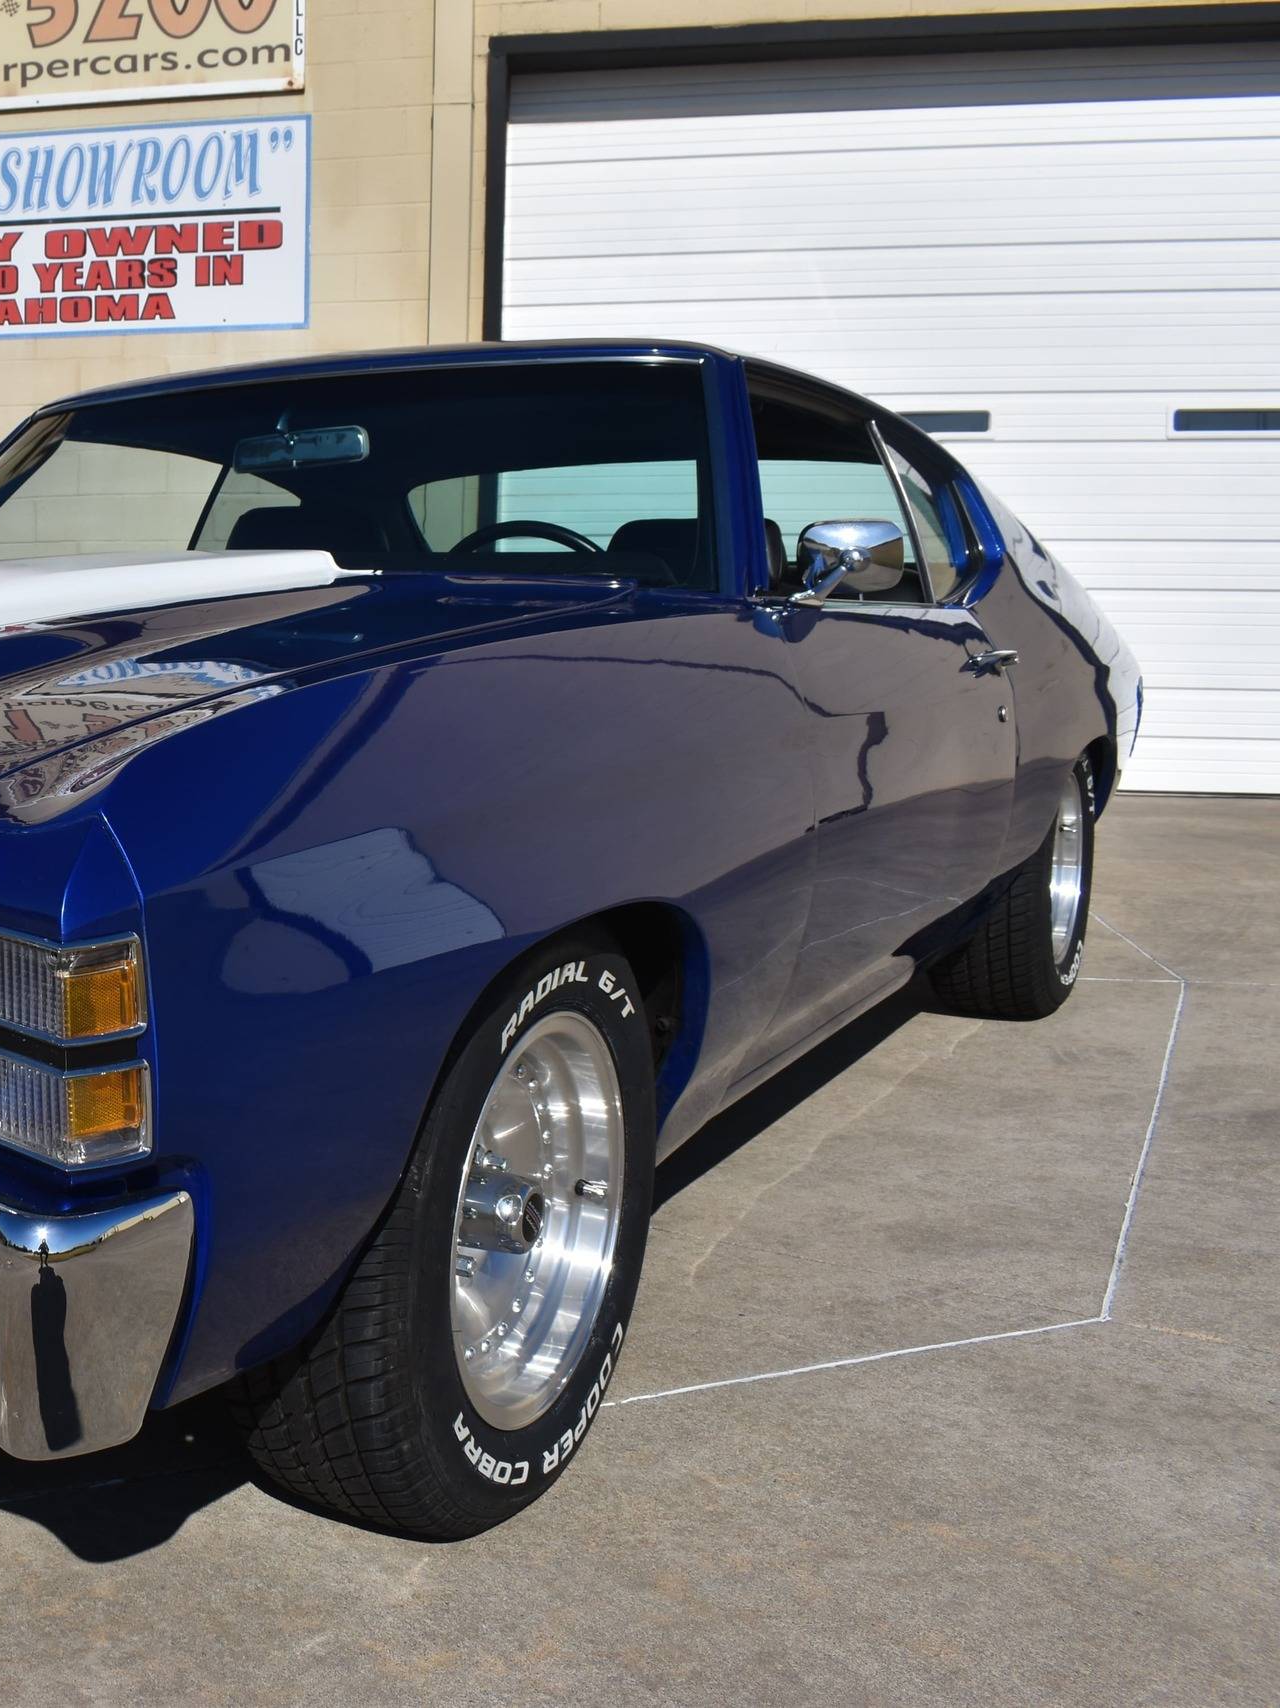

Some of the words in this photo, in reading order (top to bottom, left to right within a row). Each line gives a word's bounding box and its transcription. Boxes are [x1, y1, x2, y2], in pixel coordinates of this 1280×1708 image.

[32, 258, 178, 293] YEARS
[195, 254, 244, 287] IN
[44, 219, 283, 259] OWNED
[501, 960, 589, 1055] RADIAL
[542, 1321, 624, 1475] COOPER
[452, 1411, 530, 1486] COBRA
